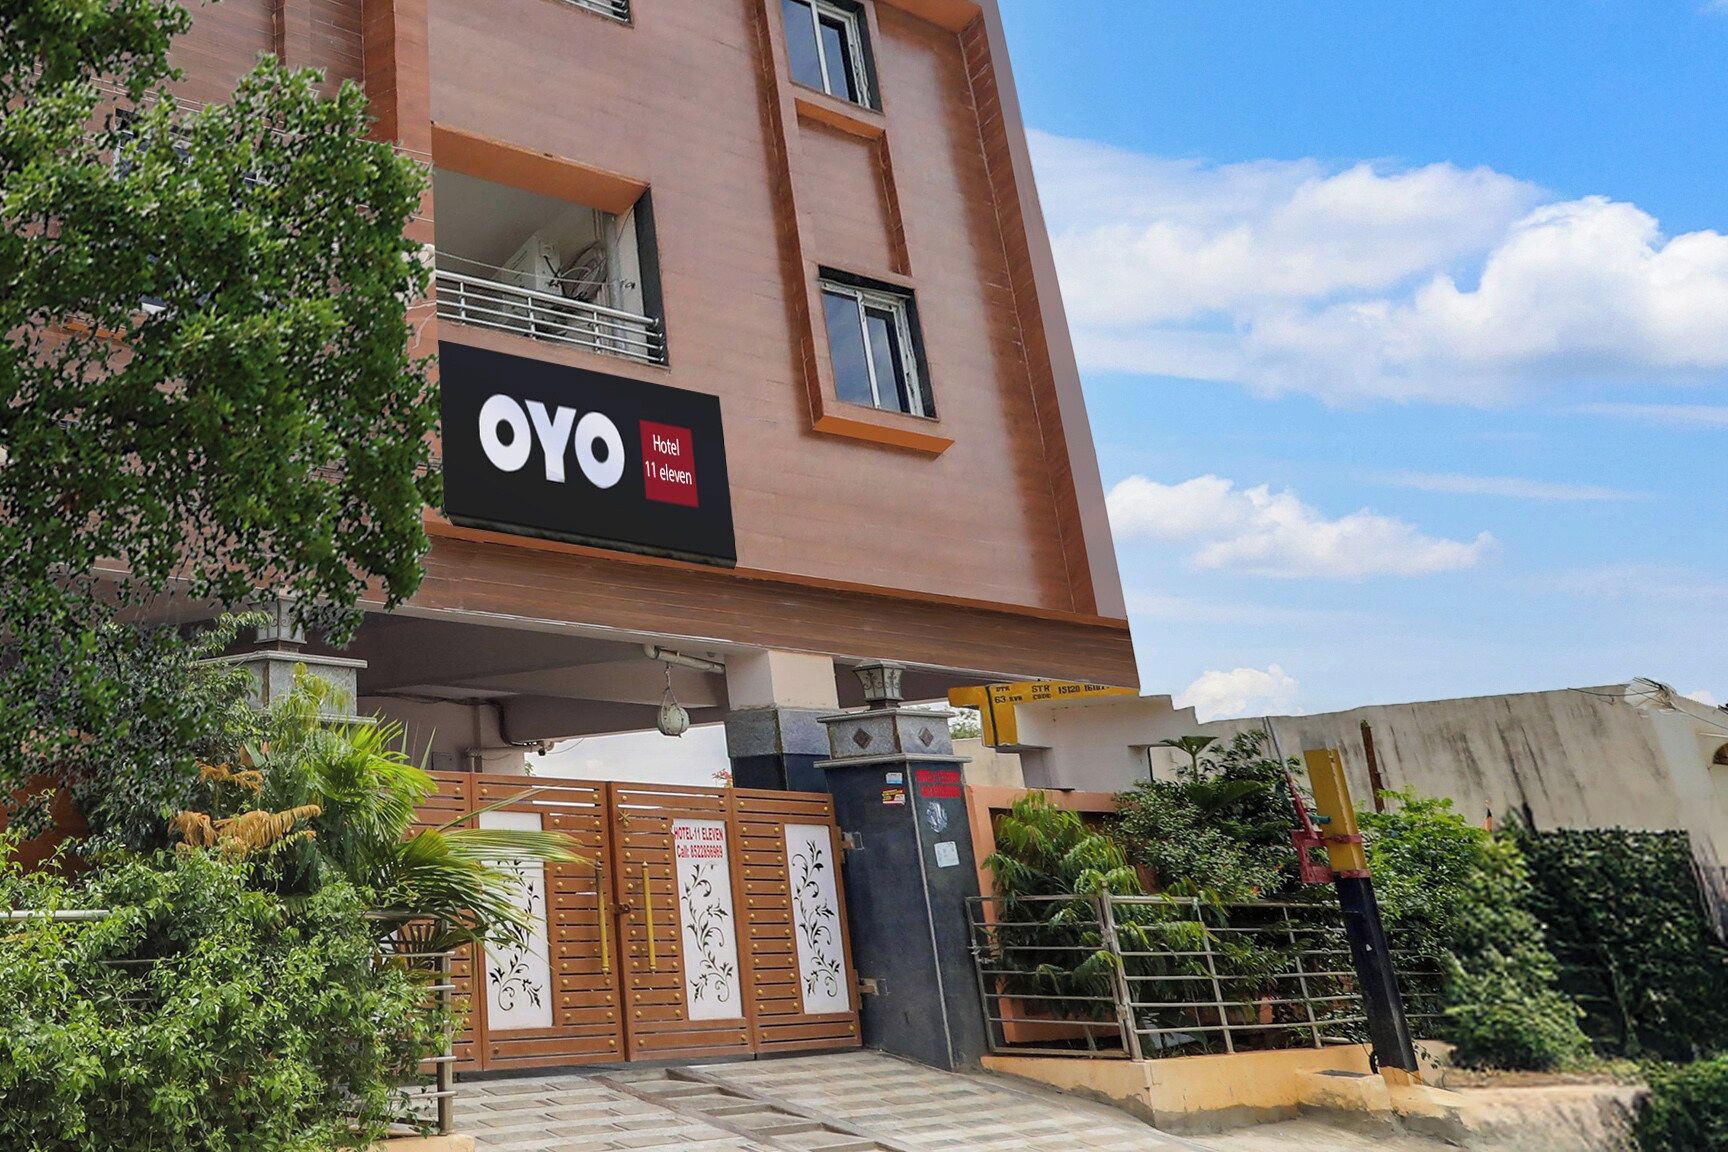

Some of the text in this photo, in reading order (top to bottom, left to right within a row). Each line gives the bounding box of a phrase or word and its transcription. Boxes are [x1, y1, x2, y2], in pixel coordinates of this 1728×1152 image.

[478, 394, 625, 489] OYO
[652, 433, 680, 456] Hotel
[645, 460, 693, 485] 11 eleven
[994, 696, 1007, 704] 63
[702, 827, 724, 841] ELEVEN
